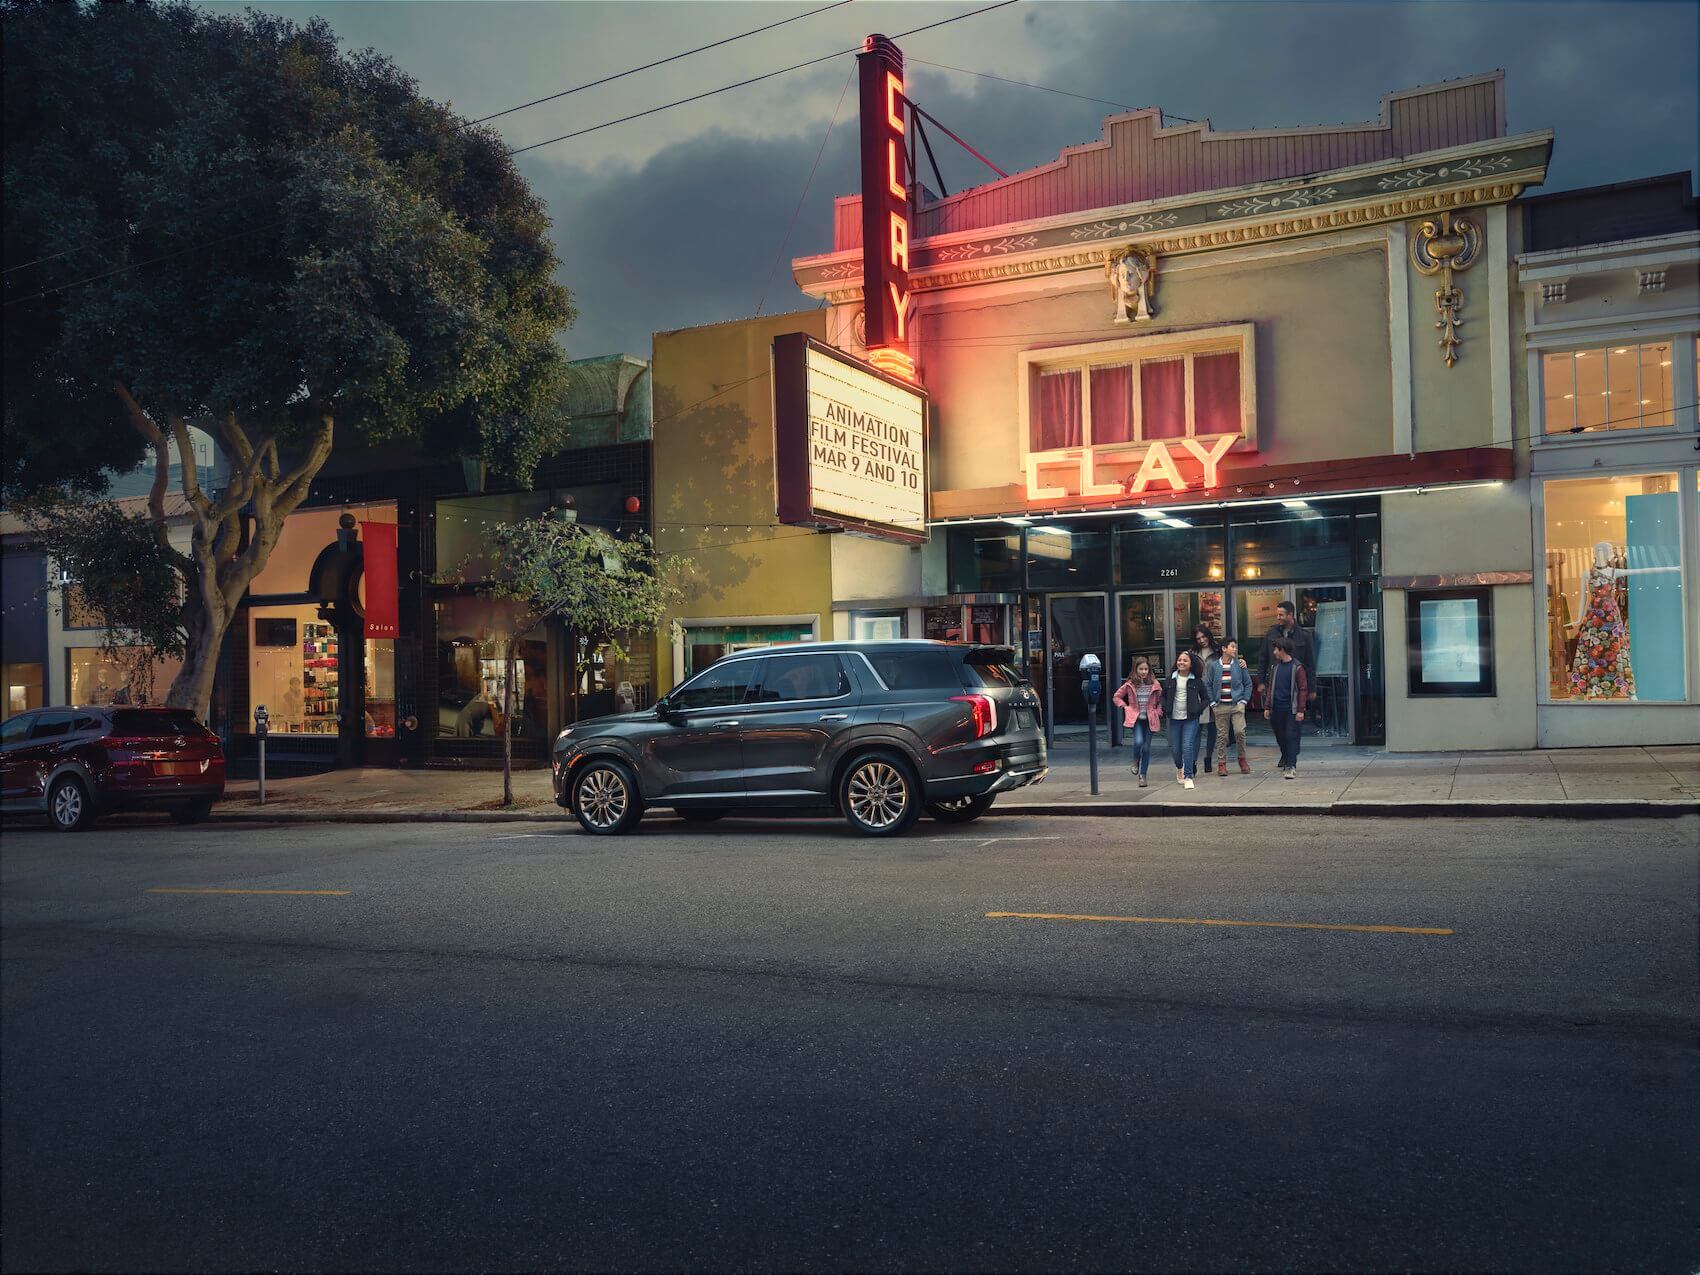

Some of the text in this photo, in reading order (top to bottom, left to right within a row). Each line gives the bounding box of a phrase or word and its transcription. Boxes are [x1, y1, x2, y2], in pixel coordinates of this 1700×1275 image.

[886, 70, 911, 342] CLAY
[811, 421, 920, 471] FILM FESTIVAL
[826, 402, 909, 448] ANIMATION
[814, 444, 917, 489] MAR 9 AND 10
[1026, 434, 1240, 500] CLAY
[1160, 568, 1178, 577] 2261
[369, 623, 394, 631] Salon
